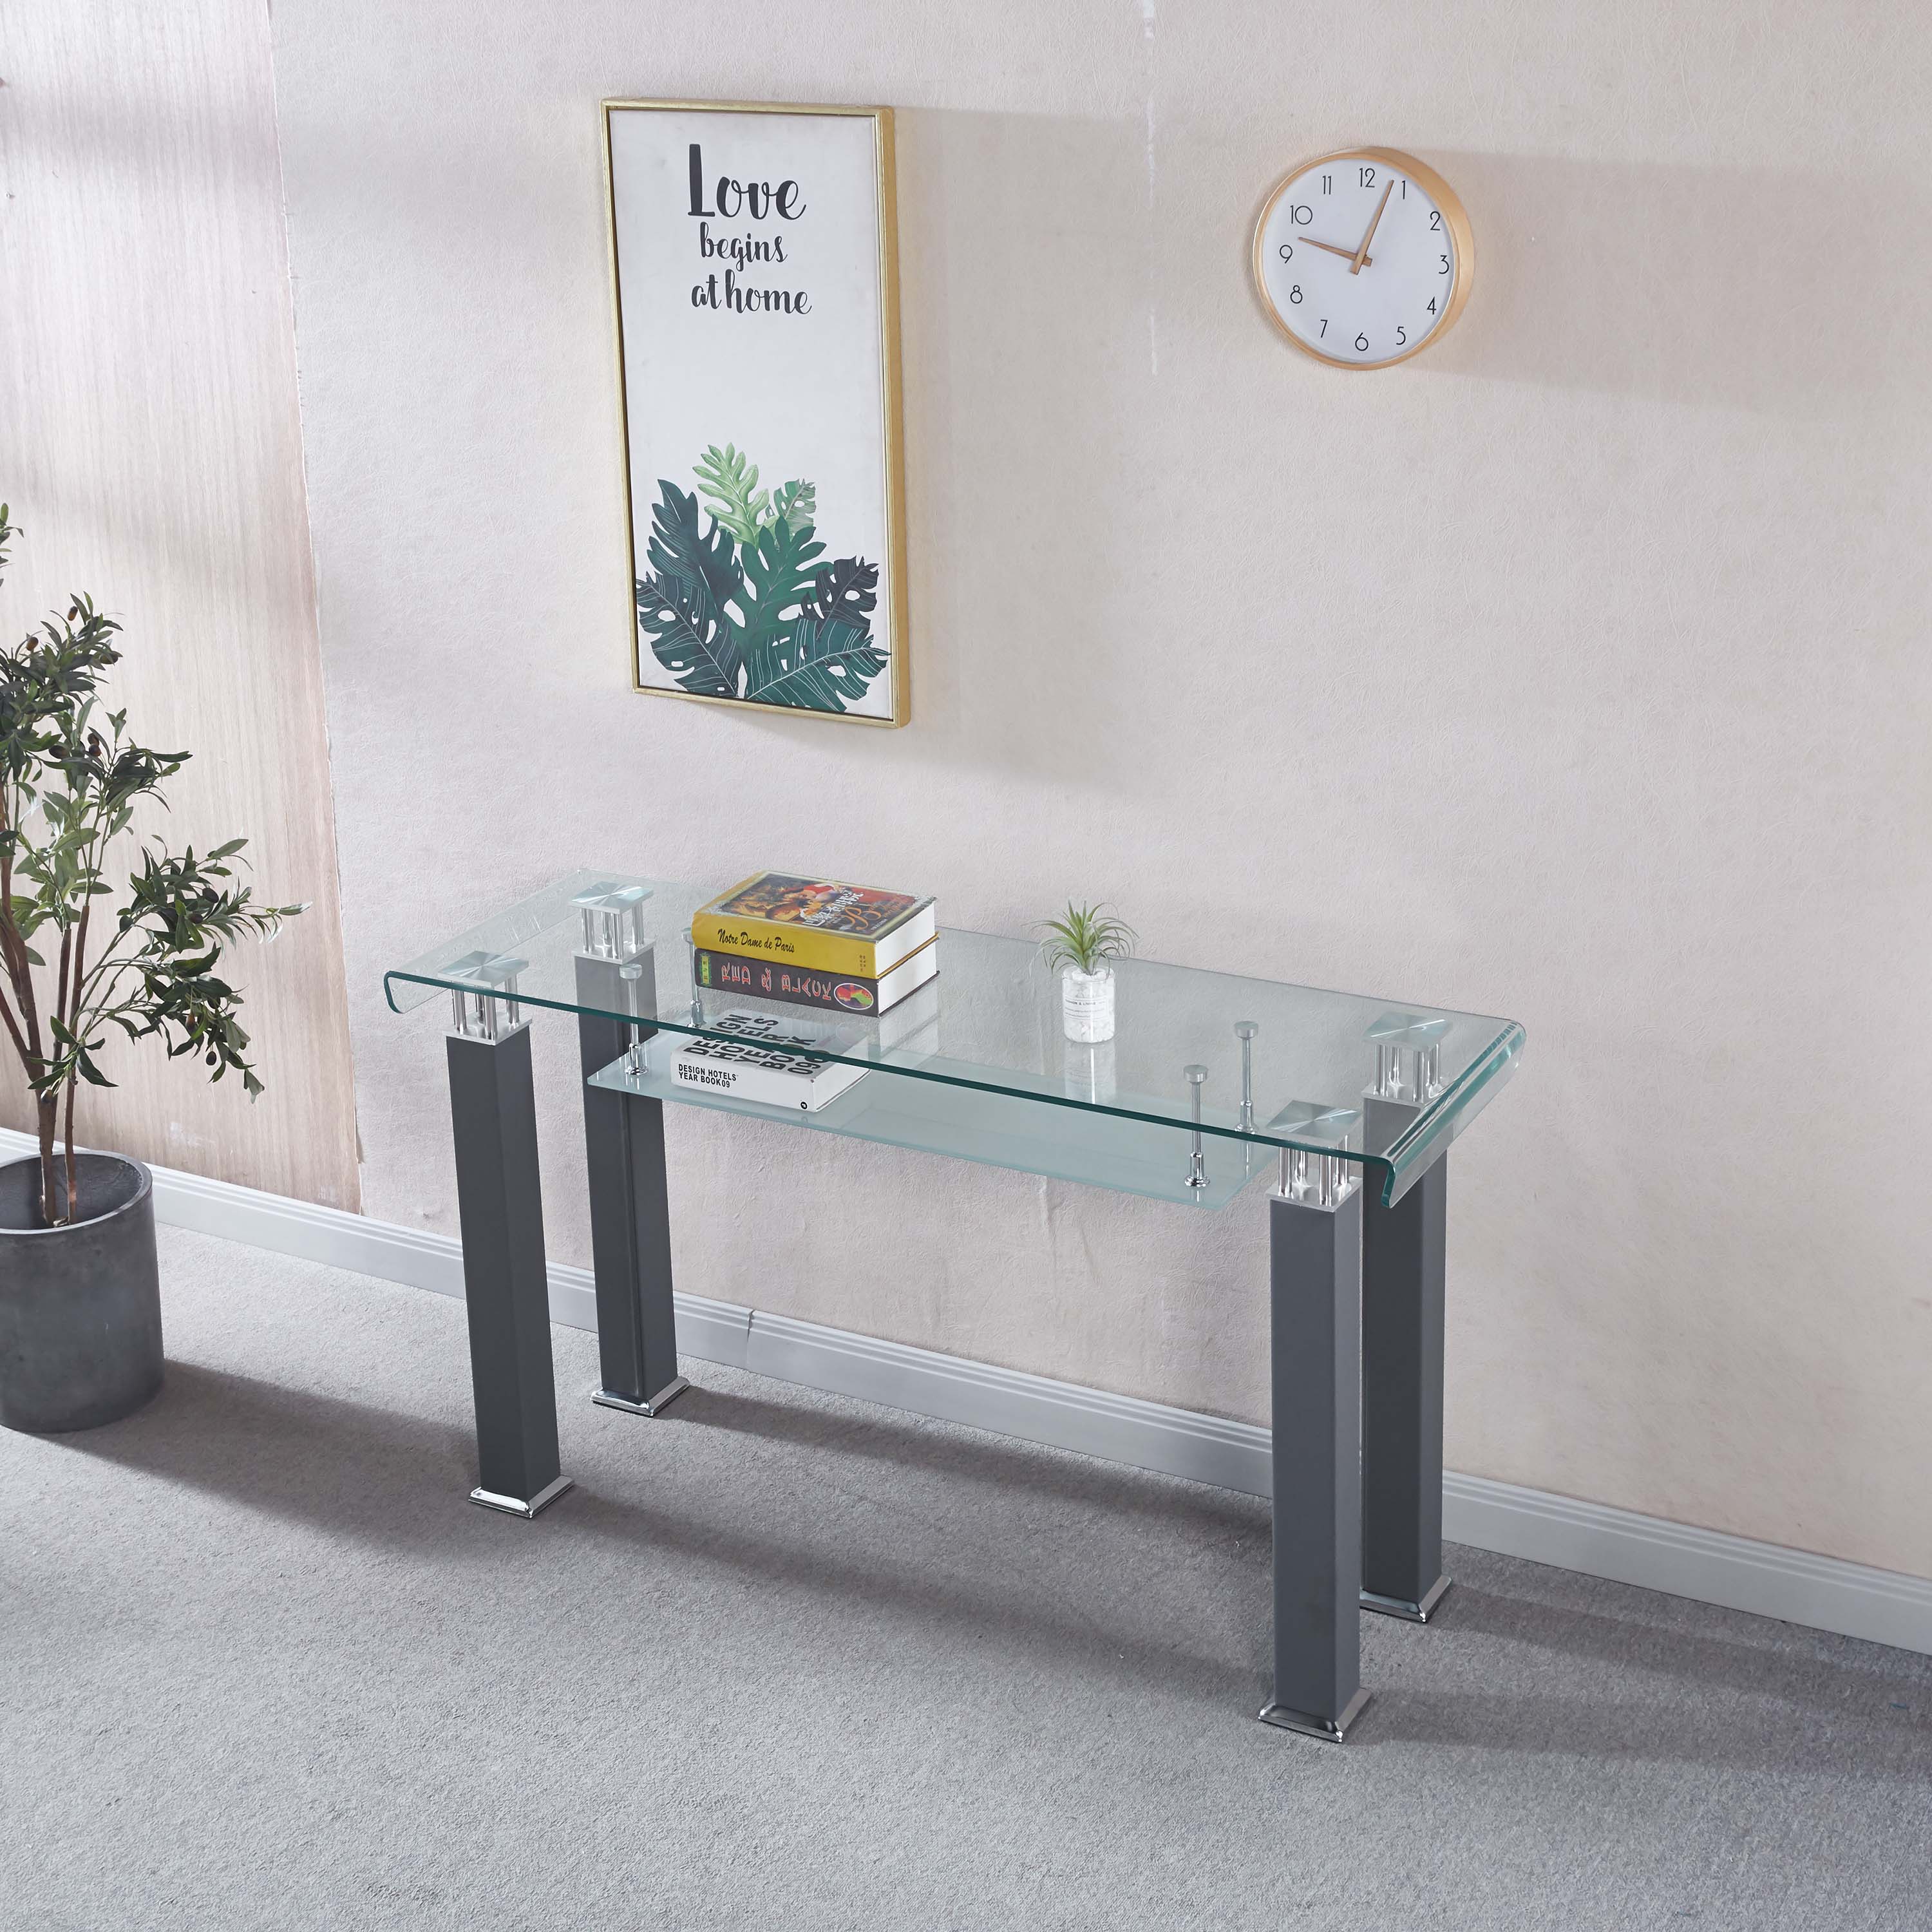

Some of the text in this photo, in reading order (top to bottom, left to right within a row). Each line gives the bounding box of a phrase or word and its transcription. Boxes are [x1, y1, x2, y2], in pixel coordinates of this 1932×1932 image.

[687, 143, 806, 220] Love
[1322, 175, 1332, 195] 11
[1359, 167, 1376, 188] 12
[1401, 180, 1406, 200] 1
[1290, 205, 1313, 225] 10
[1430, 211, 1441, 231] 2
[700, 222, 788, 272] begins
[1279, 245, 1293, 263] 9
[1438, 254, 1450, 274] 3
[1289, 285, 1303, 304] 8
[1426, 296, 1437, 315] 4
[1320, 319, 1328, 338] 7
[1396, 327, 1406, 345] 5
[1355, 332, 1369, 351] 6
[717, 928, 795, 952] Notre Dame de Paris
[721, 962, 751, 985] RED
[782, 974, 831, 1001] BLACK
[708, 1018, 779, 1060] HOELS
[733, 1034, 790, 1064] YER
[678, 1063, 737, 1081] DESIGN HOTELS
[678, 1071, 698, 1082] YEAR
